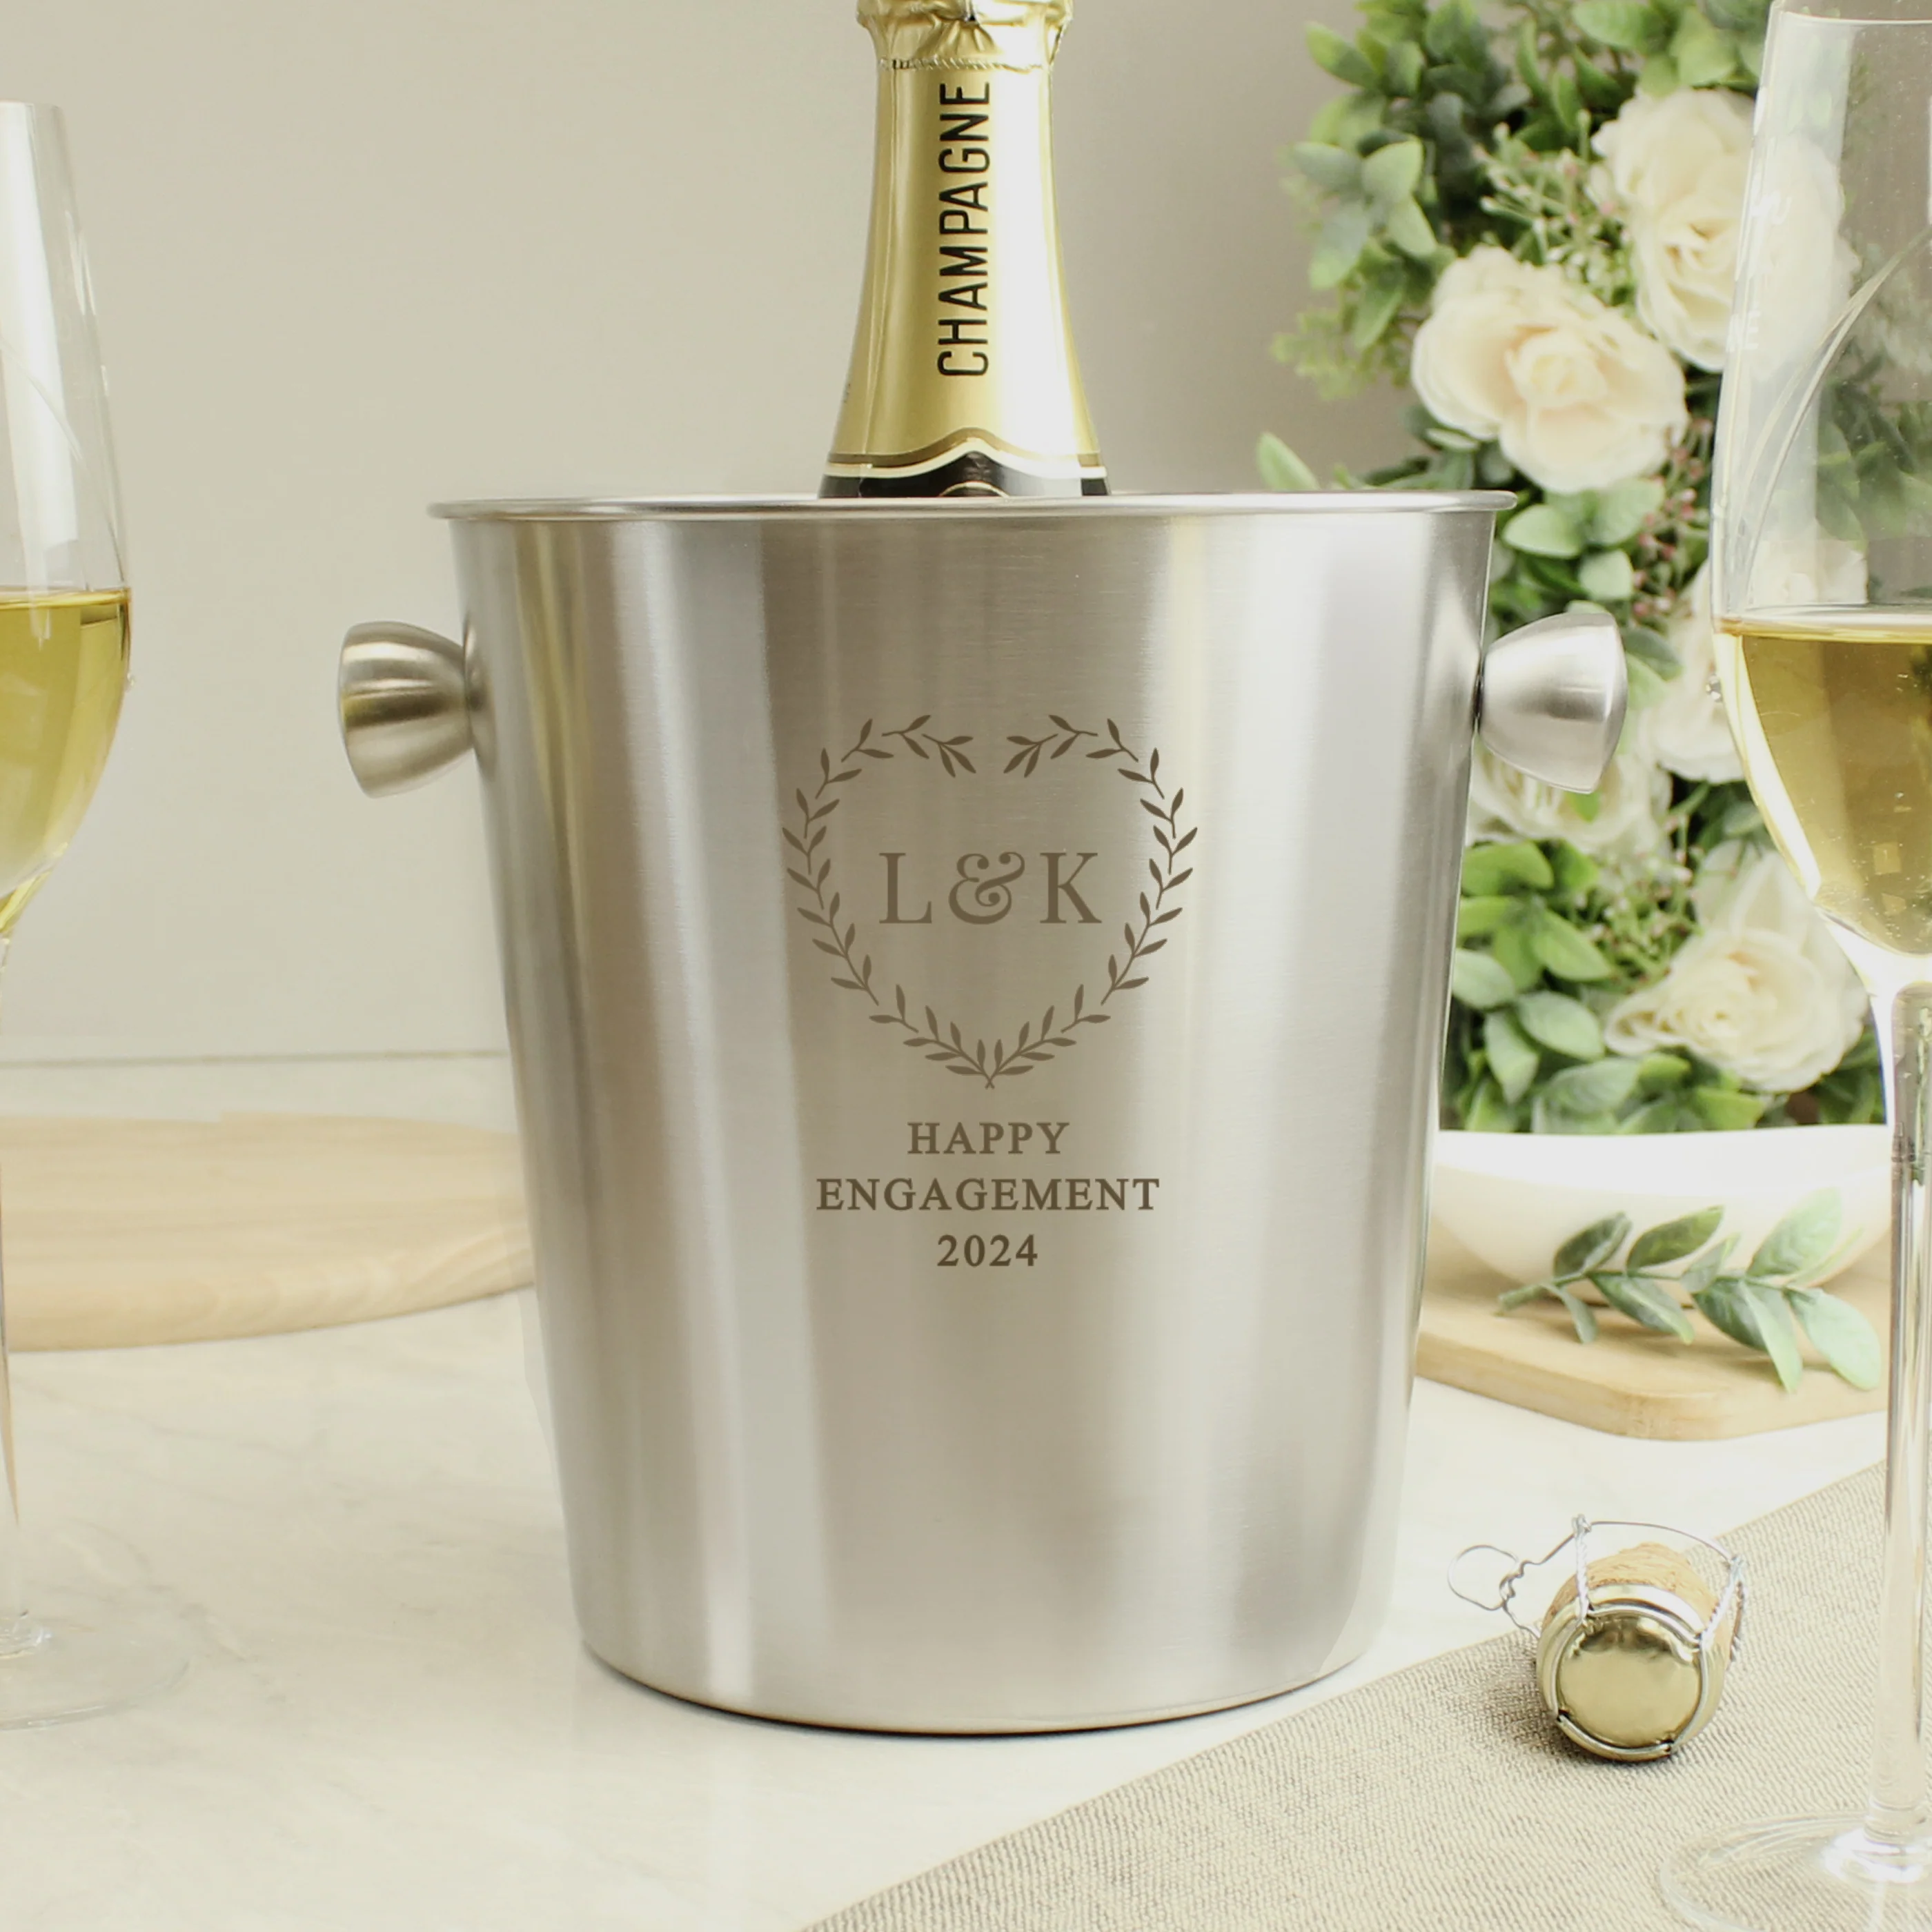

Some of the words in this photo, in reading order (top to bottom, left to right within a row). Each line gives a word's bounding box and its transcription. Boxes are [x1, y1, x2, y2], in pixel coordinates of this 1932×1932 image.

[937, 82, 990, 377] CHAMPAGNE
[907, 1121, 1070, 1155] HAPPY
[816, 1177, 1161, 1212] ENGAGEMENT
[936, 1233, 1038, 1268] 2024
